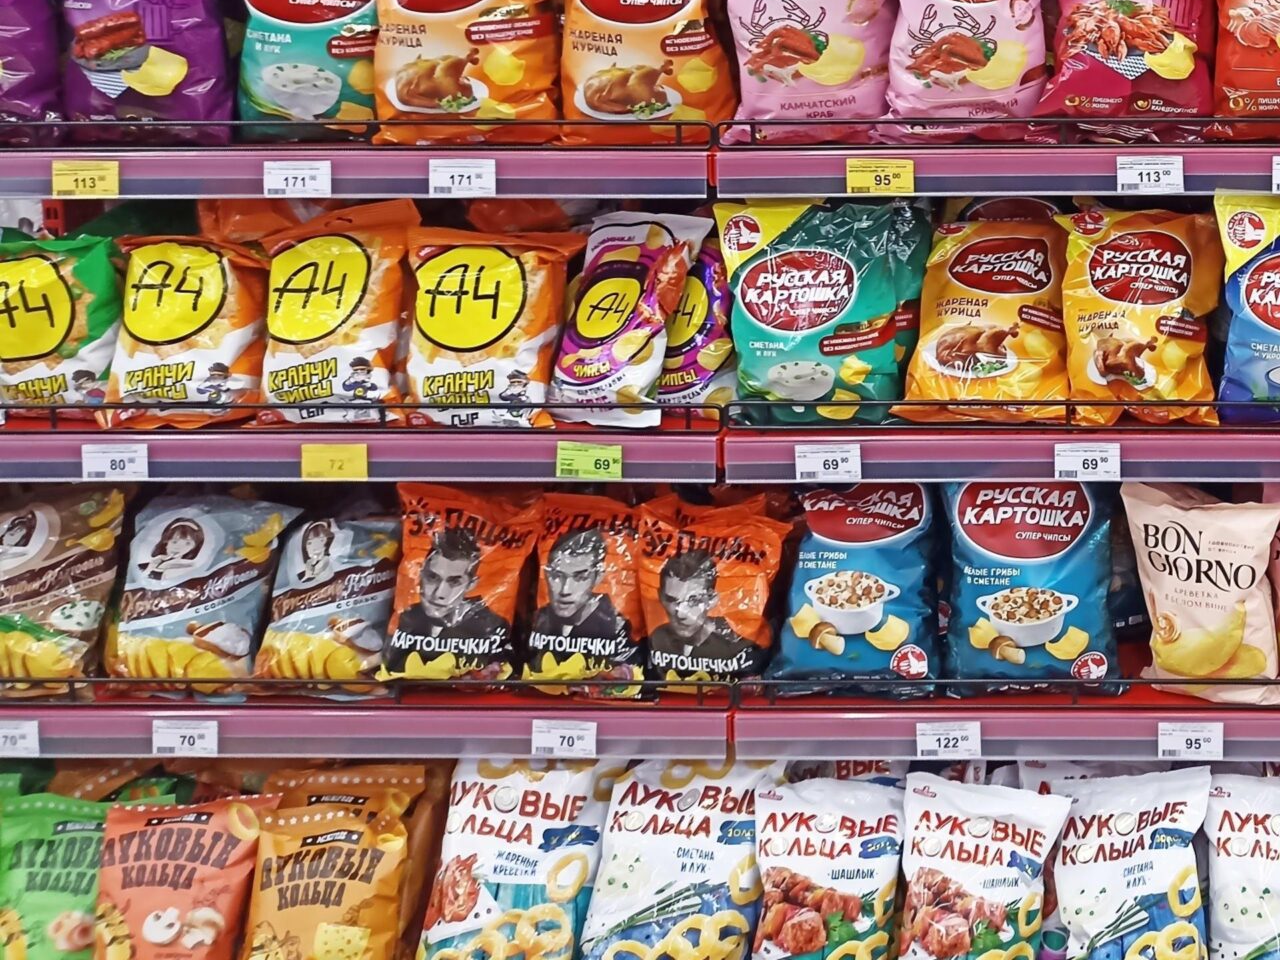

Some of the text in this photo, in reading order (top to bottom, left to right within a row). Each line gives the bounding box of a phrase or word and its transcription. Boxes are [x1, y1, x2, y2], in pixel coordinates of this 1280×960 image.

[780, 95, 856, 111] КАМЧАТСКИЙ
[284, 177, 305, 187] 171
[450, 175, 471, 185] 171
[875, 175, 890, 185] 95
[1102, 250, 1186, 268] РУССКАЯ
[757, 269, 847, 286] РУССКАЯ
[745, 285, 850, 303] КАРТОШКА
[125, 361, 195, 390] КРАНЧИ
[268, 358, 338, 390] КРАНЧИ
[423, 371, 494, 395] КРАНЧИ
[110, 459, 125, 470] 80
[595, 459, 610, 470] 69
[823, 459, 838, 470] 69
[1083, 459, 1097, 469] 69
[978, 487, 1077, 508] РУССКАЯ
[963, 505, 1088, 527] КАРТОШКА
[1143, 521, 1203, 557] BON
[992, 568, 1021, 576] ГРИБЫ
[1148, 551, 1256, 592] GIORNO
[180, 736, 195, 746] 70
[936, 737, 958, 748] 122
[762, 812, 897, 835] ЛУКОВЫЕ
[759, 838, 852, 858] КОЛЬЦА
[121, 866, 197, 889] КОЛЬЦА
[831, 869, 875, 880] ШАШЛЫК
[277, 881, 346, 909] КОЛЬЦА
